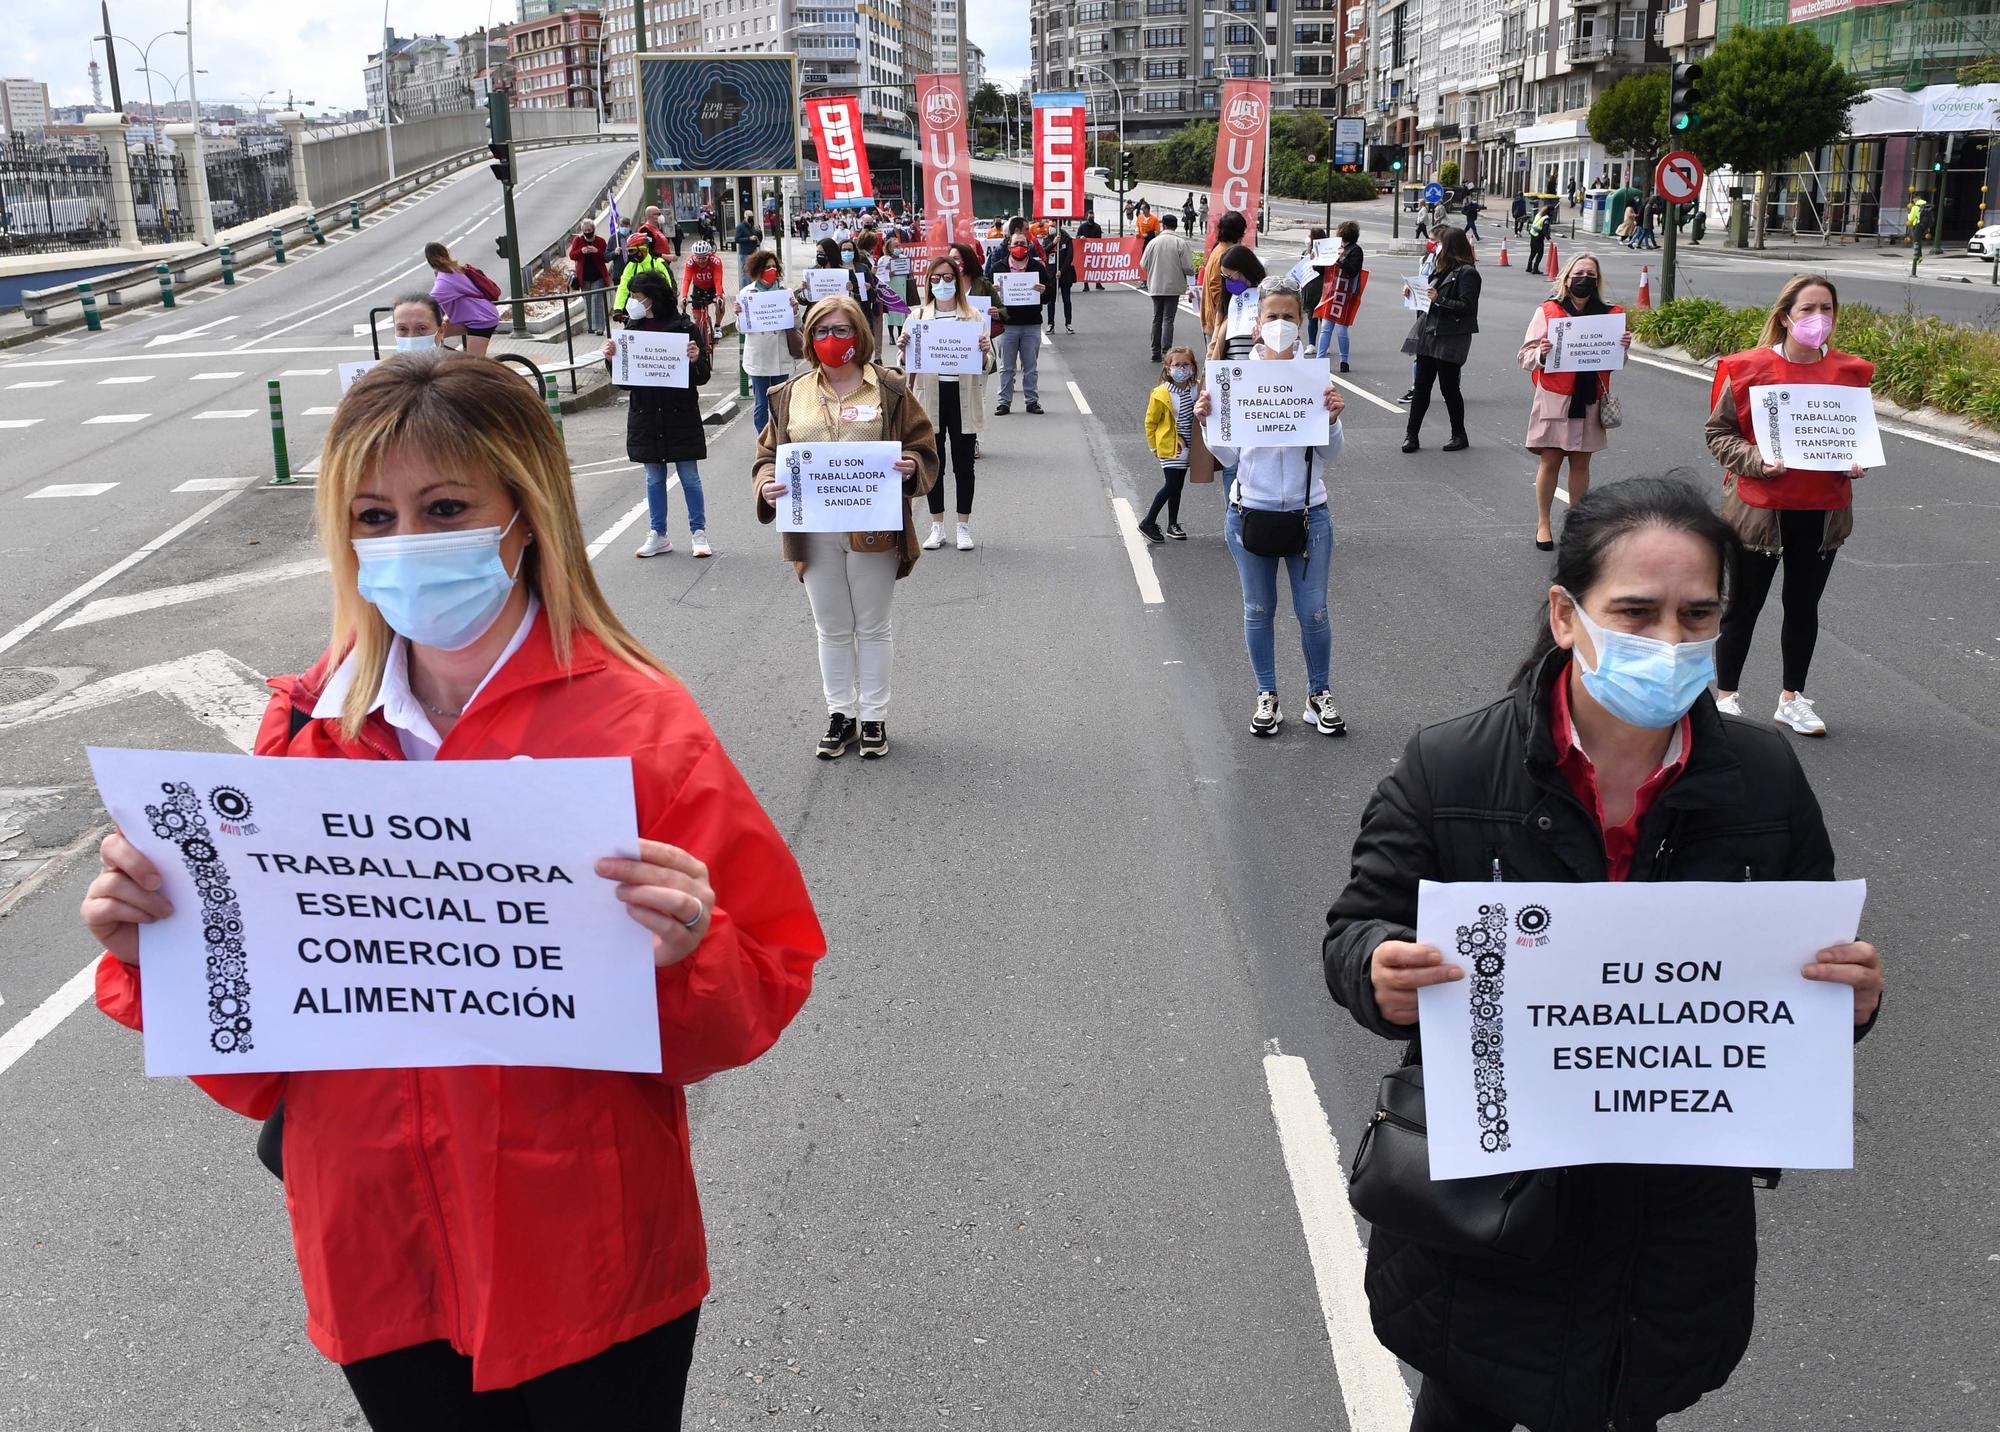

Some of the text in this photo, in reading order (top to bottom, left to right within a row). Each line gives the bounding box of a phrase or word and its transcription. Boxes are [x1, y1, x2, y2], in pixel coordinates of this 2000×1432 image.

[927, 94, 955, 112] UGT
[1232, 99, 1260, 116] UGT
[1932, 102, 1984, 112] VORWERK
[1043, 107, 1073, 217] CCOO
[1222, 138, 1253, 213] UG
[929, 132, 961, 245] UGT
[1084, 241, 1120, 253] POR UN
[1083, 253, 1131, 269] FUTURO
[1084, 269, 1141, 282] INDUSTRIAL
[632, 354, 681, 362] TRABALLADORA
[1257, 385, 1293, 394] EU SON
[1237, 397, 1314, 407] TRABALLADORA
[1807, 400, 1841, 409] EU SON
[1244, 410, 1306, 420] ESENCIAL DE
[1790, 413, 1857, 423] TRABALLADOR
[1256, 424, 1297, 433] LIMPEZA
[1795, 426, 1855, 436] ESENCIAL DO
[1795, 439, 1857, 448] TRANSPORTE
[829, 458, 864, 467] EU SON
[1803, 452, 1853, 460] SANITARIO
[808, 471, 886, 481] TRABALLADORA
[817, 484, 879, 494] ESENCIAL DE
[824, 498, 872, 507] SANIDADE
[321, 812, 472, 842] EU SON
[246, 852, 574, 885] TRABALLADORA
[296, 892, 550, 925] ESENCIAL DE
[1534, 934, 1551, 947] 2021
[296, 937, 564, 971] COMERCIO DE
[1601, 960, 1722, 985] EU SON
[292, 985, 576, 1020] ALIMENTACIÓN
[1526, 1000, 1795, 1028] TRABALLADORA
[1553, 1044, 1767, 1070] ESENCIAL DE
[1594, 1089, 1734, 1114] LIMPEZA
